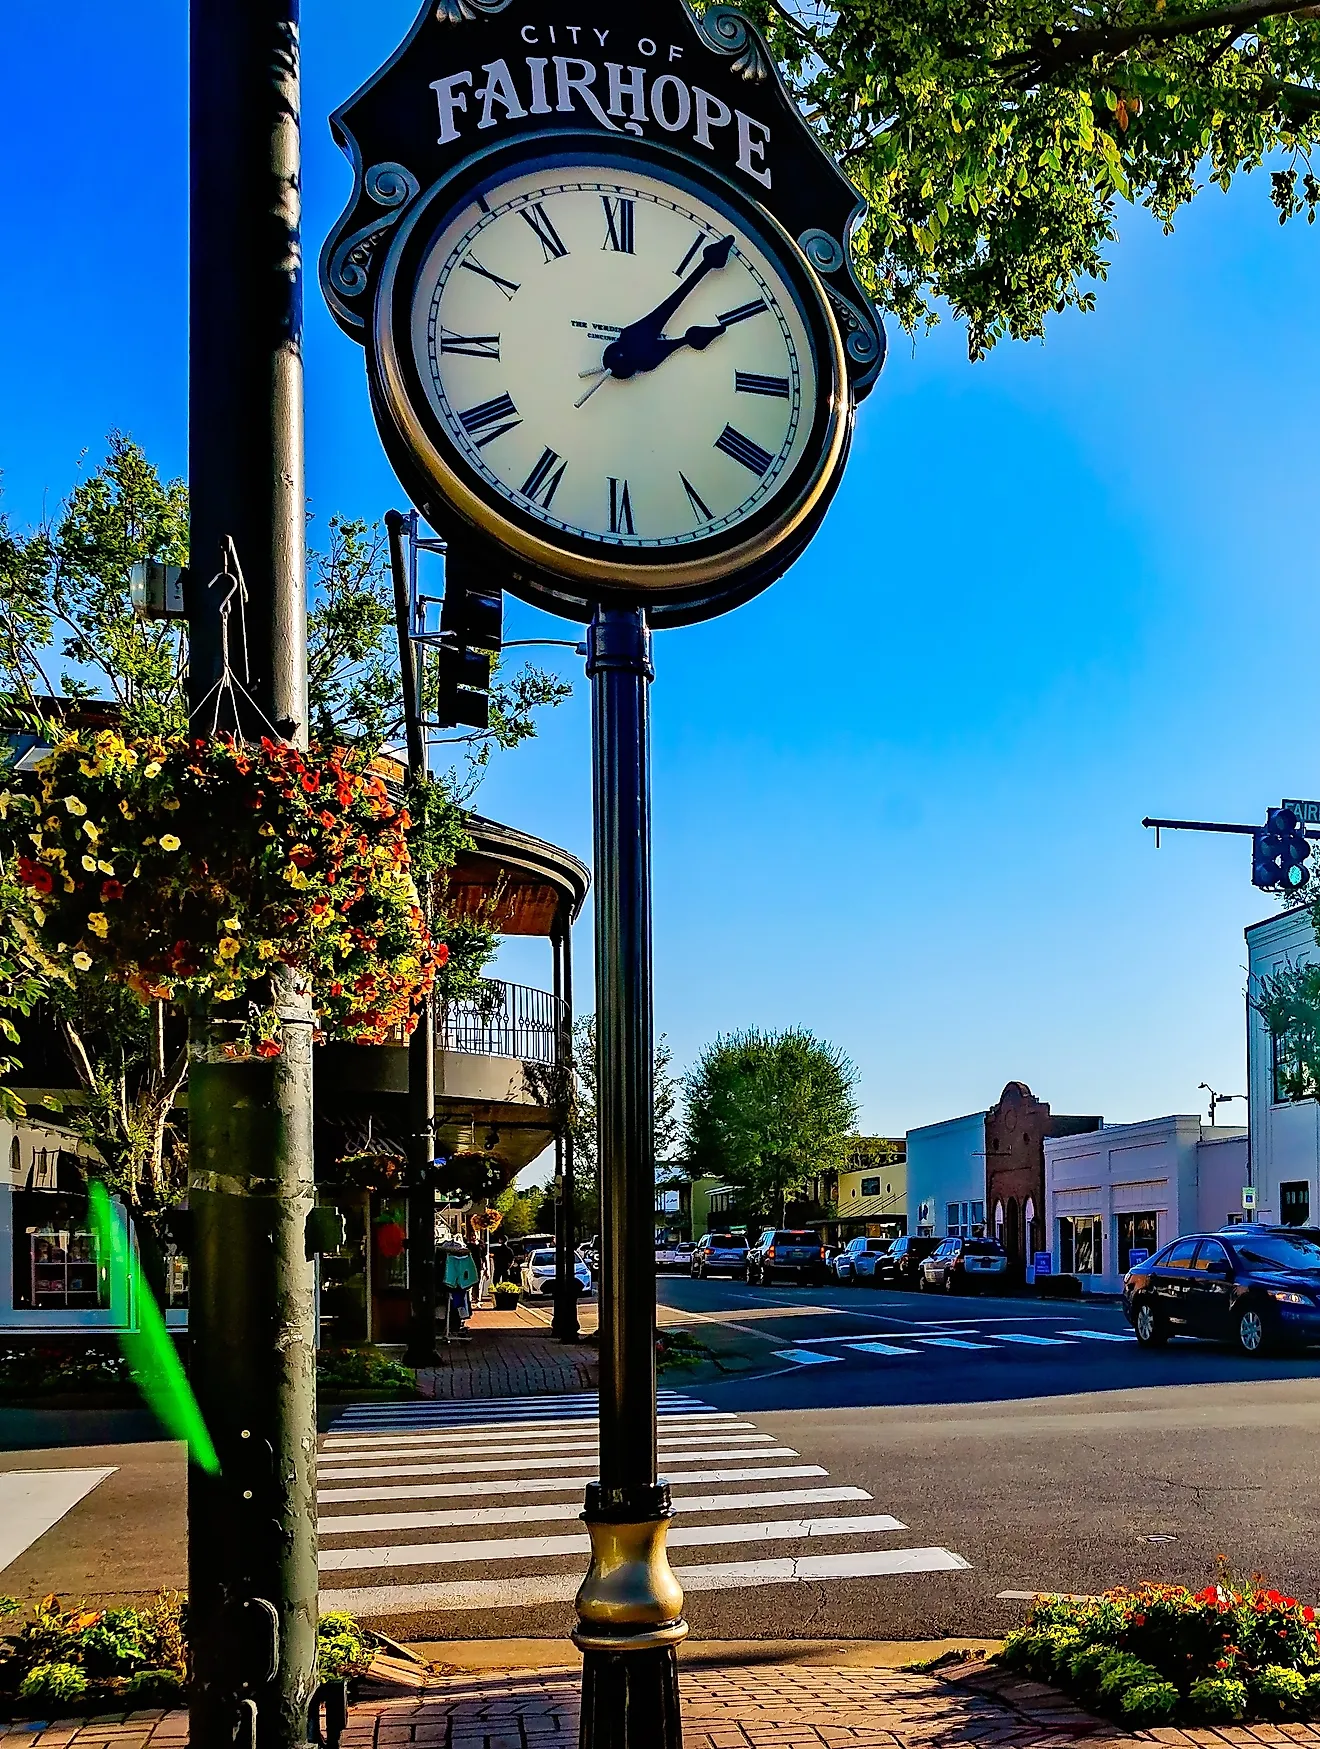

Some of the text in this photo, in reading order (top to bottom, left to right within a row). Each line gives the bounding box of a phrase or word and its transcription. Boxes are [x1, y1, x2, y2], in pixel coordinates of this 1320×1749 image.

[521, 25, 684, 62] CITY OF
[429, 56, 772, 190] FAIRHOPE
[600, 195, 636, 255] XII
[459, 249, 522, 301] X
[570, 320, 587, 328] THE
[735, 369, 790, 401] III
